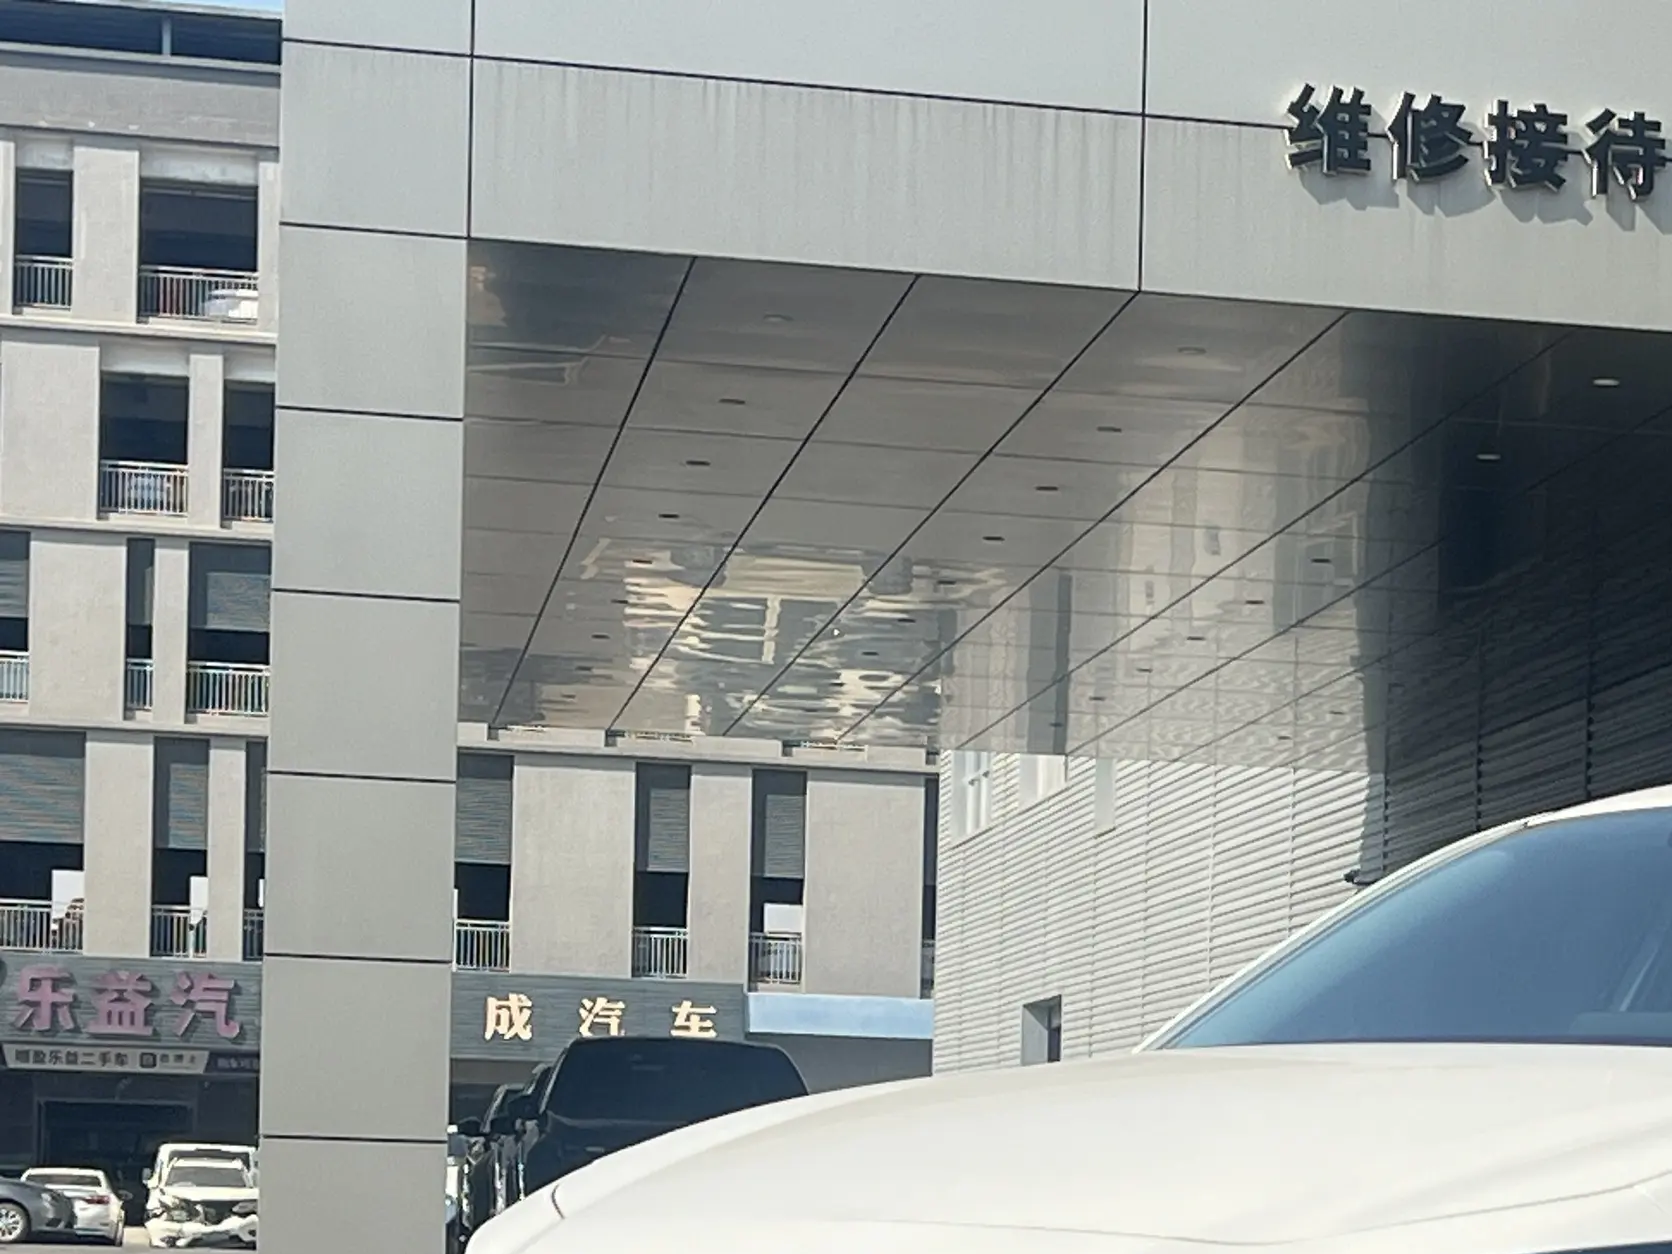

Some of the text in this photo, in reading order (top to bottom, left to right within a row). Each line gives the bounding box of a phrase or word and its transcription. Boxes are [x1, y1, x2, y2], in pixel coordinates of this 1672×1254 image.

[1283, 83, 1667, 201] 维修接待
[13, 964, 240, 1038] 乐益汽
